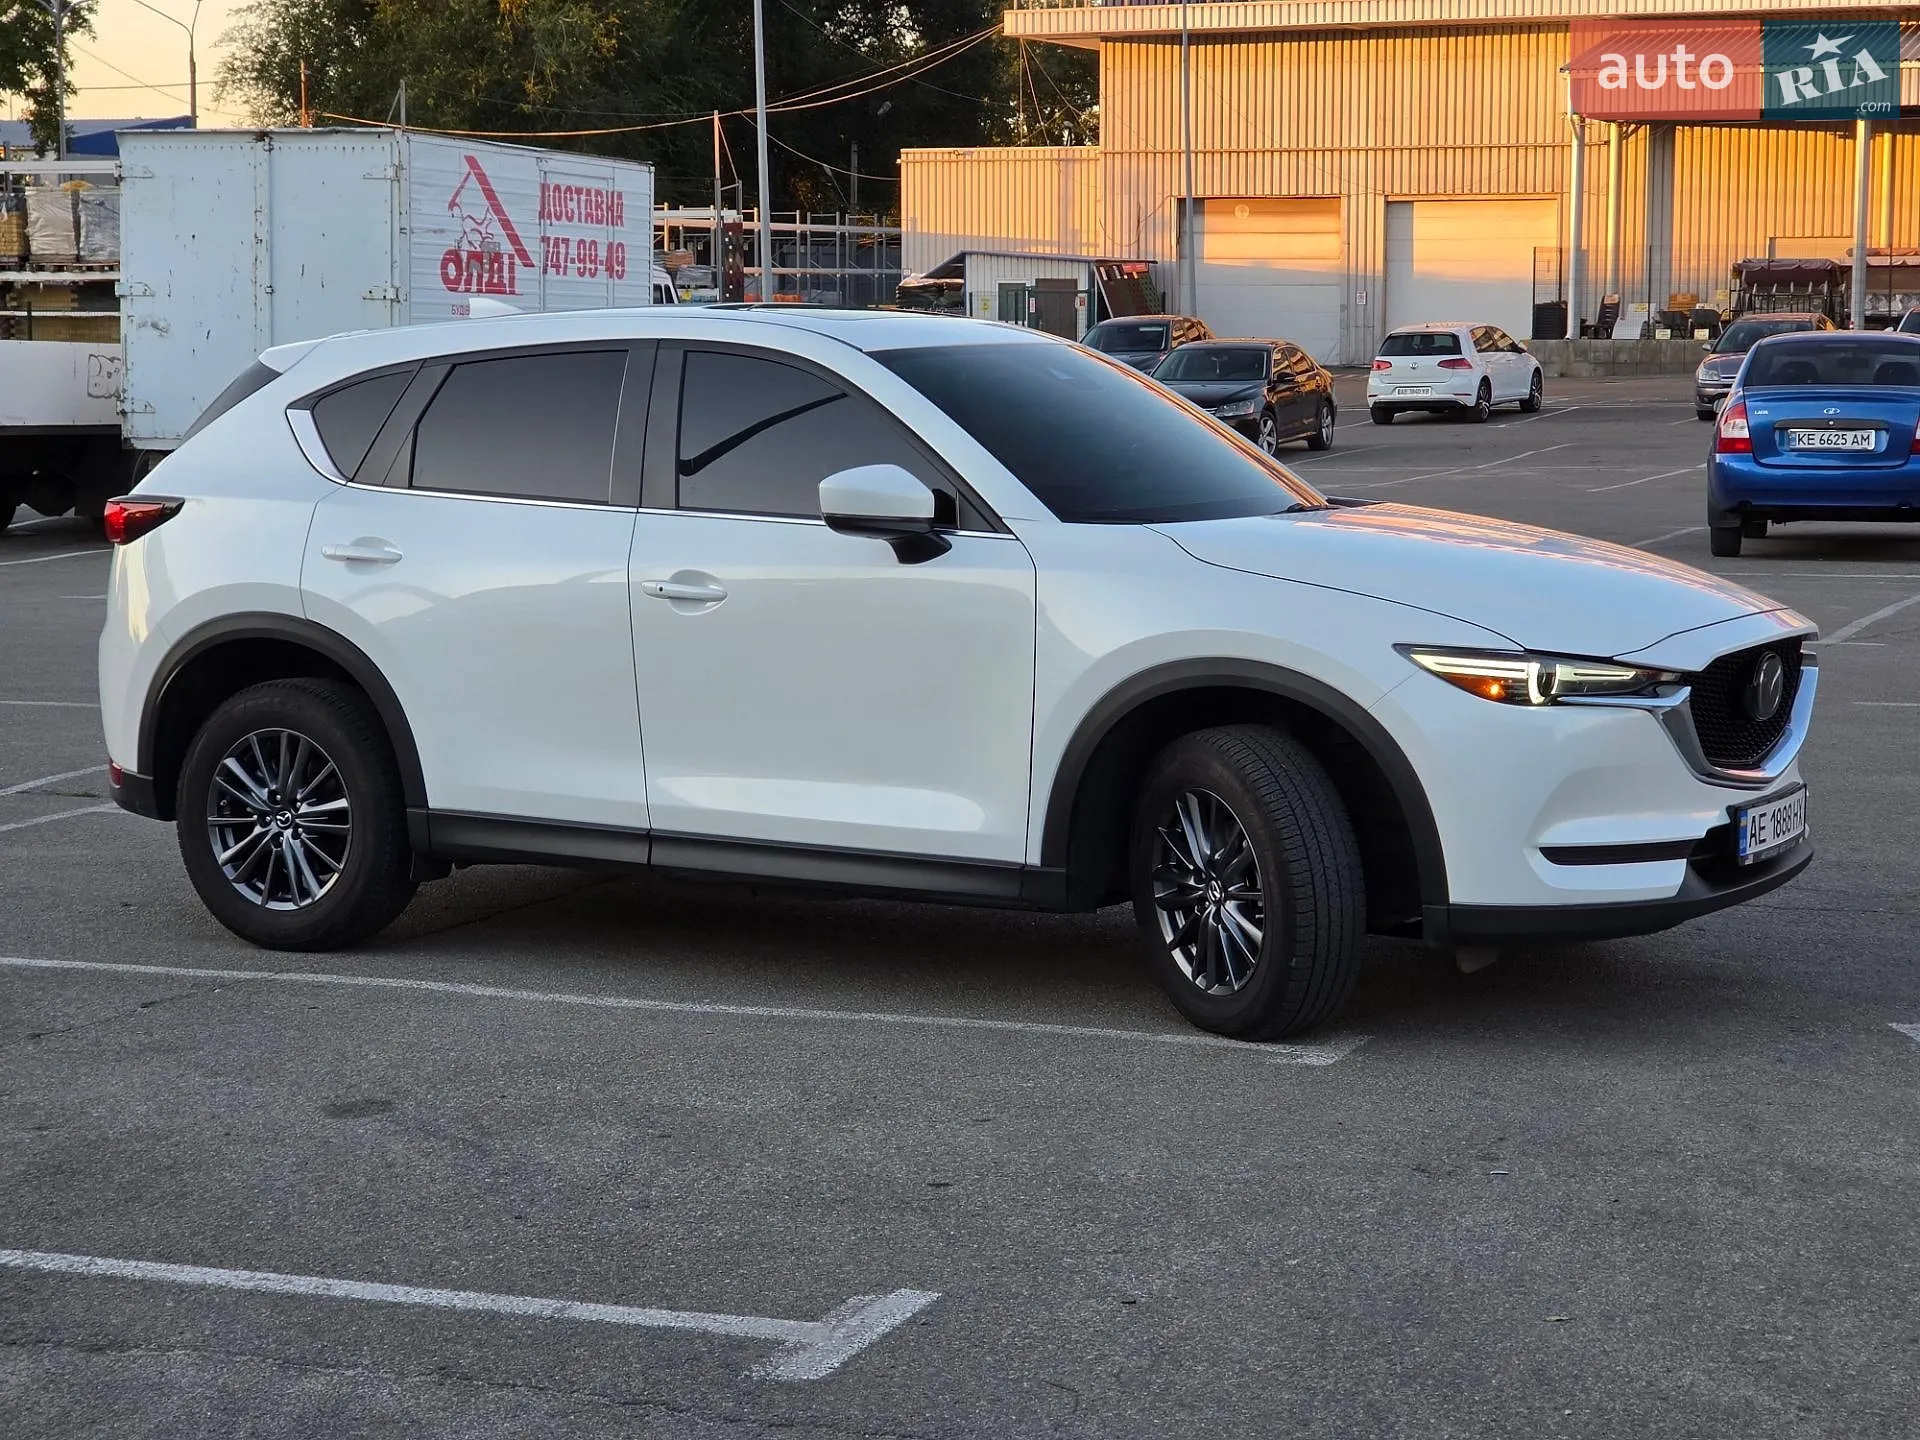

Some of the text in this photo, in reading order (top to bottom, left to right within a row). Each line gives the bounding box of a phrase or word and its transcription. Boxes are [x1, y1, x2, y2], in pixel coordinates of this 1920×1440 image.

[541, 236, 625, 280] 747-99-49
[1797, 433, 1815, 446] KE
[1819, 433, 1848, 446] 6625
[1851, 433, 1870, 446] AM
[1749, 812, 1767, 847] AE
[1792, 796, 1804, 831] HX
